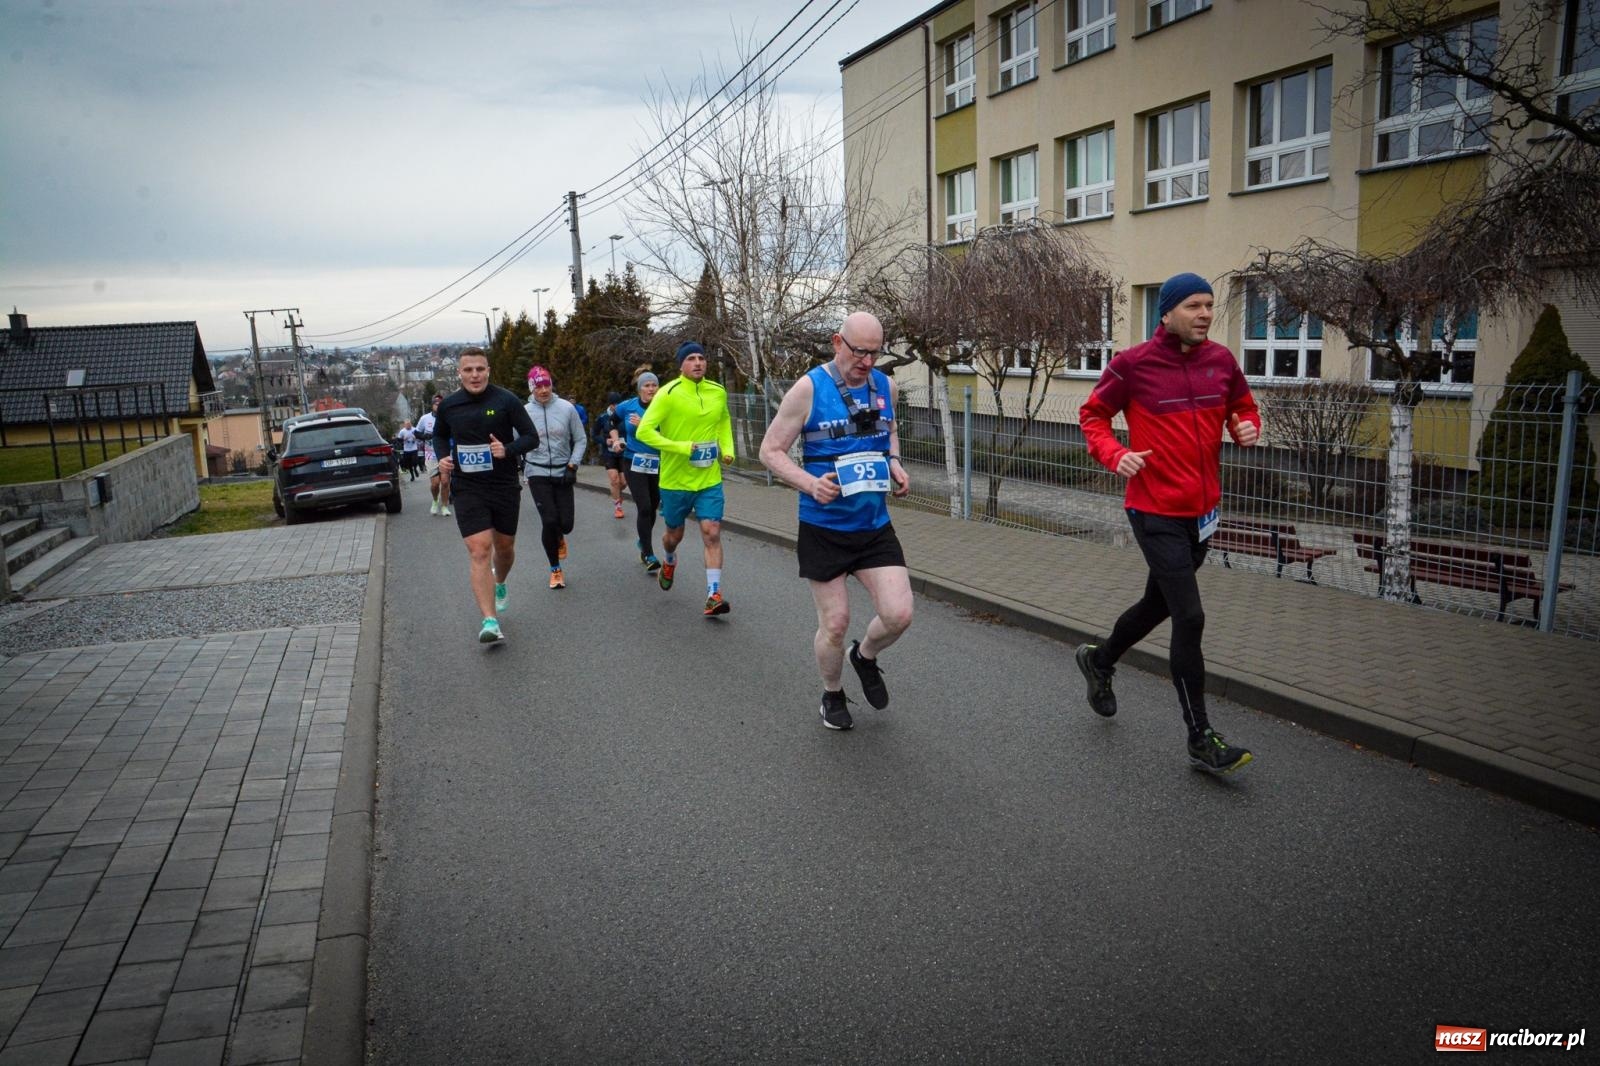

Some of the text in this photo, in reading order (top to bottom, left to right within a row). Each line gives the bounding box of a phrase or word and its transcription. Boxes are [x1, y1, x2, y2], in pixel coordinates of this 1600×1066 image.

[462, 452, 485, 465] 205
[699, 448, 712, 460] 75
[640, 459, 652, 468] 24
[853, 462, 877, 480] 95
